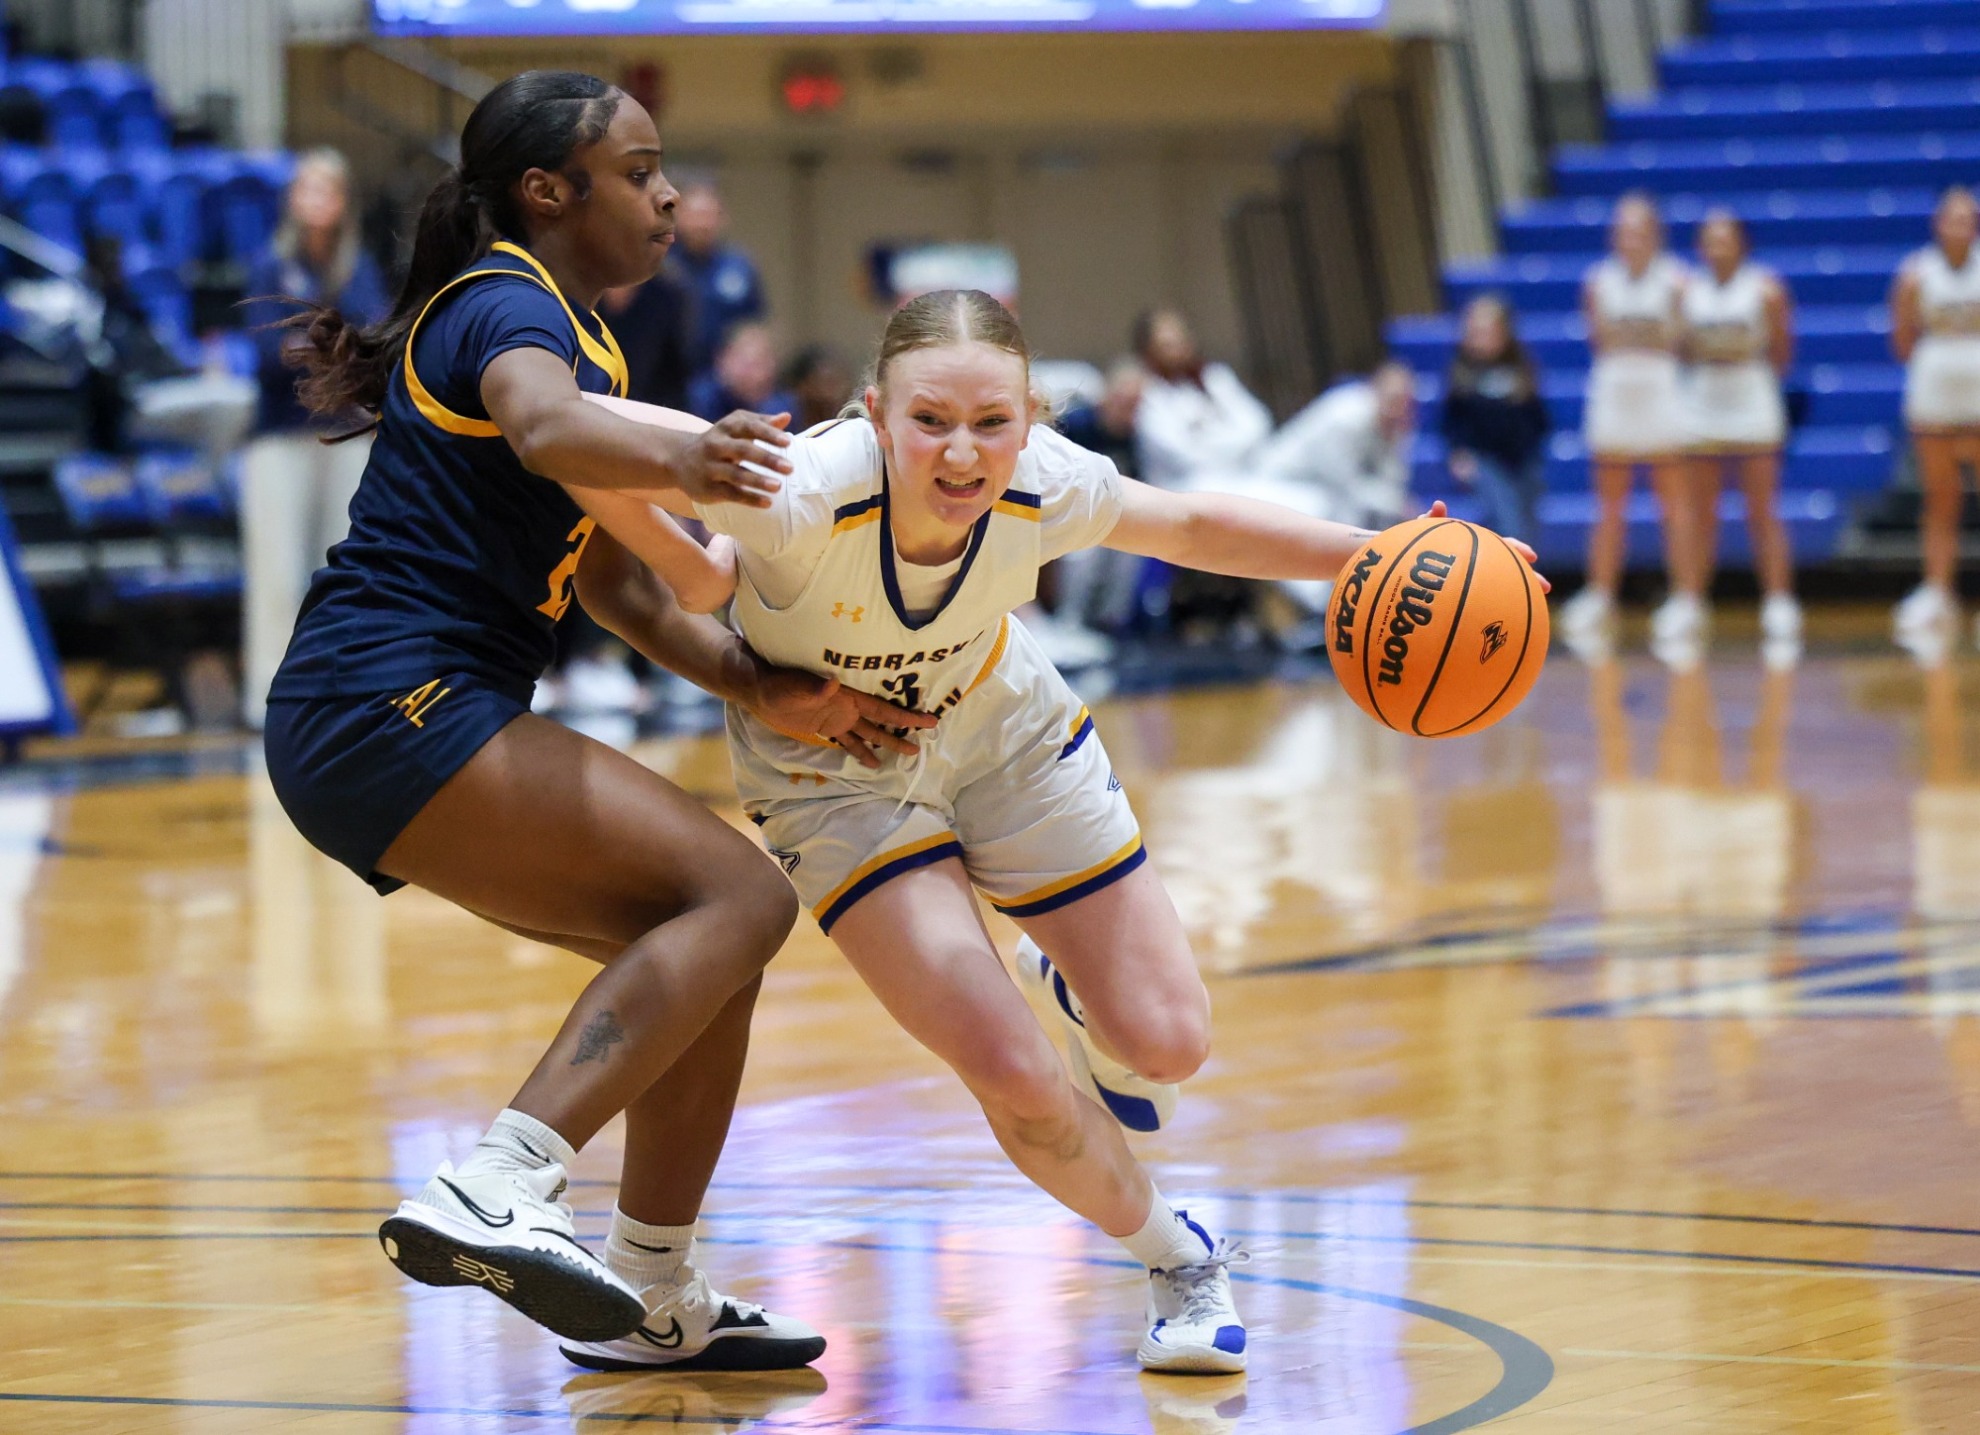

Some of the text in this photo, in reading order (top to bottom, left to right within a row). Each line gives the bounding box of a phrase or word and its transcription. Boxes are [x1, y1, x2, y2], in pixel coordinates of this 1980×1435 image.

[823, 630, 985, 671] NEBRASK
[1335, 548, 1383, 654] NCAA
[1378, 550, 1457, 686] Wilson
